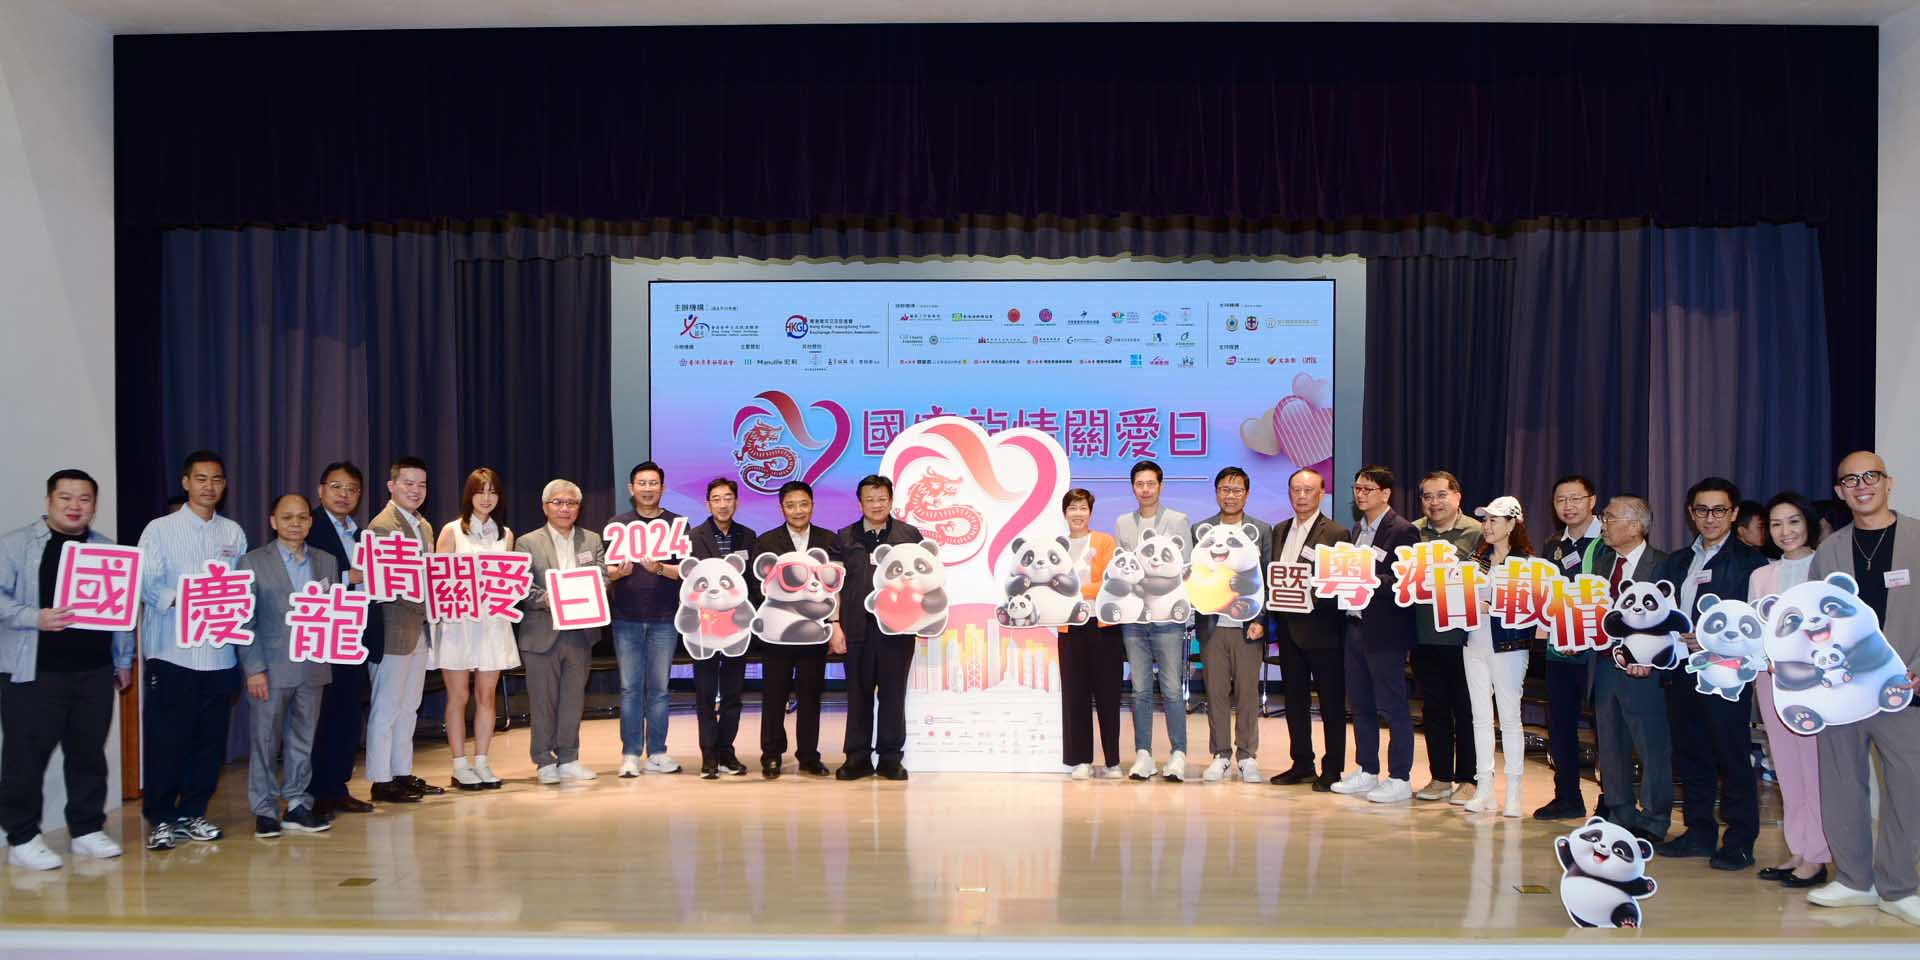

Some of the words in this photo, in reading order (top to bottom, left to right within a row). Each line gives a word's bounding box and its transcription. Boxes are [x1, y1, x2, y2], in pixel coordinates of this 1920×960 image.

[786, 322, 808, 332] HKGD
[357, 533, 423, 598] 情
[606, 519, 689, 562] 2024
[61, 546, 139, 626] 國
[180, 563, 251, 643] 慶
[551, 569, 607, 626] 日
[1270, 565, 1308, 609] 暨
[1550, 578, 1611, 647] 情
[291, 586, 366, 660] 龍
